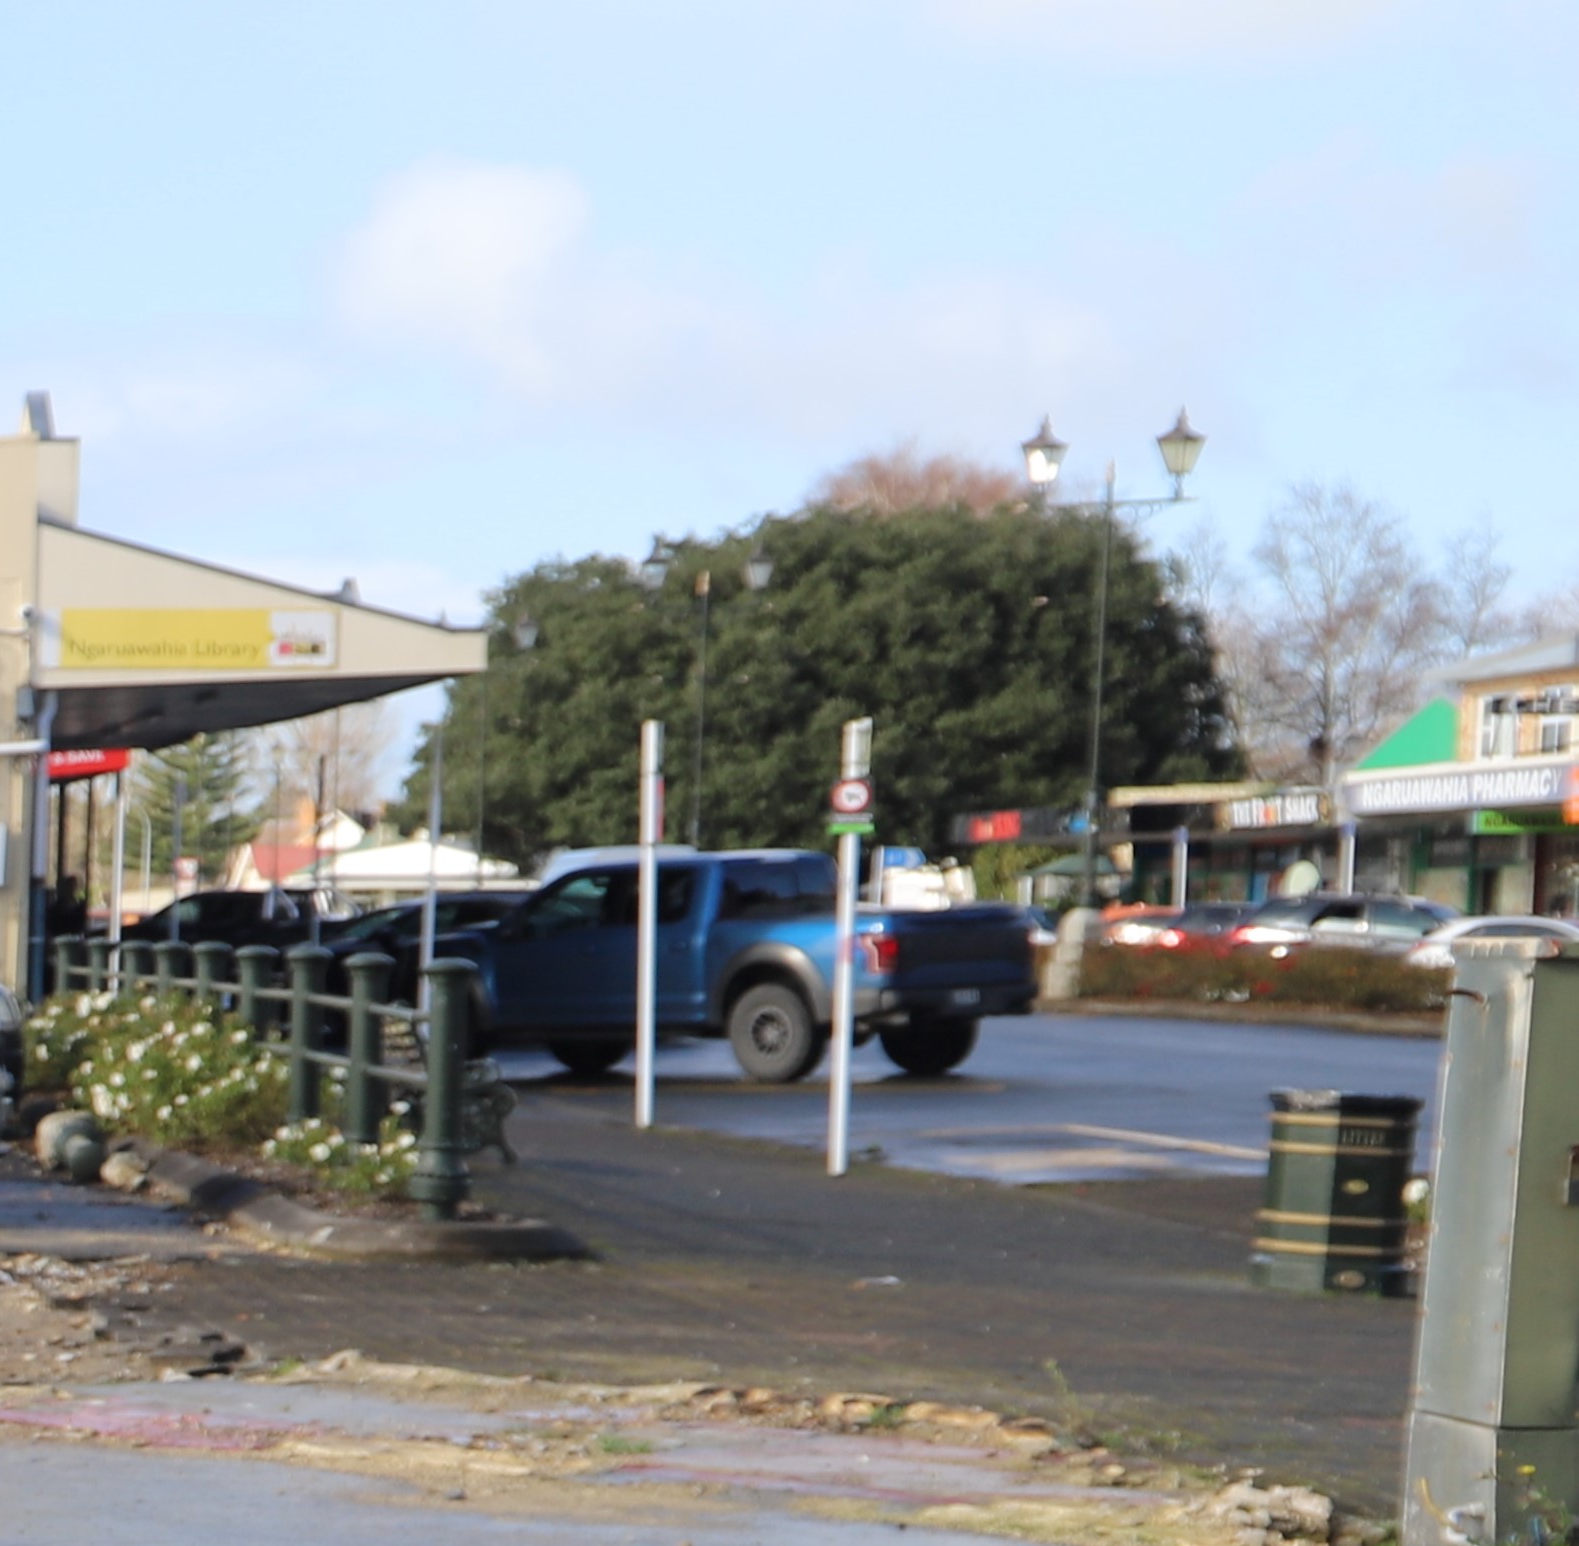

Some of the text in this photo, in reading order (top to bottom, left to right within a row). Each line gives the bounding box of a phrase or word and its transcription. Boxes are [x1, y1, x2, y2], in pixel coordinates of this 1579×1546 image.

[195, 639, 262, 662] Library
[1362, 767, 1562, 808] NGARUAWAHIA PHARMACY
